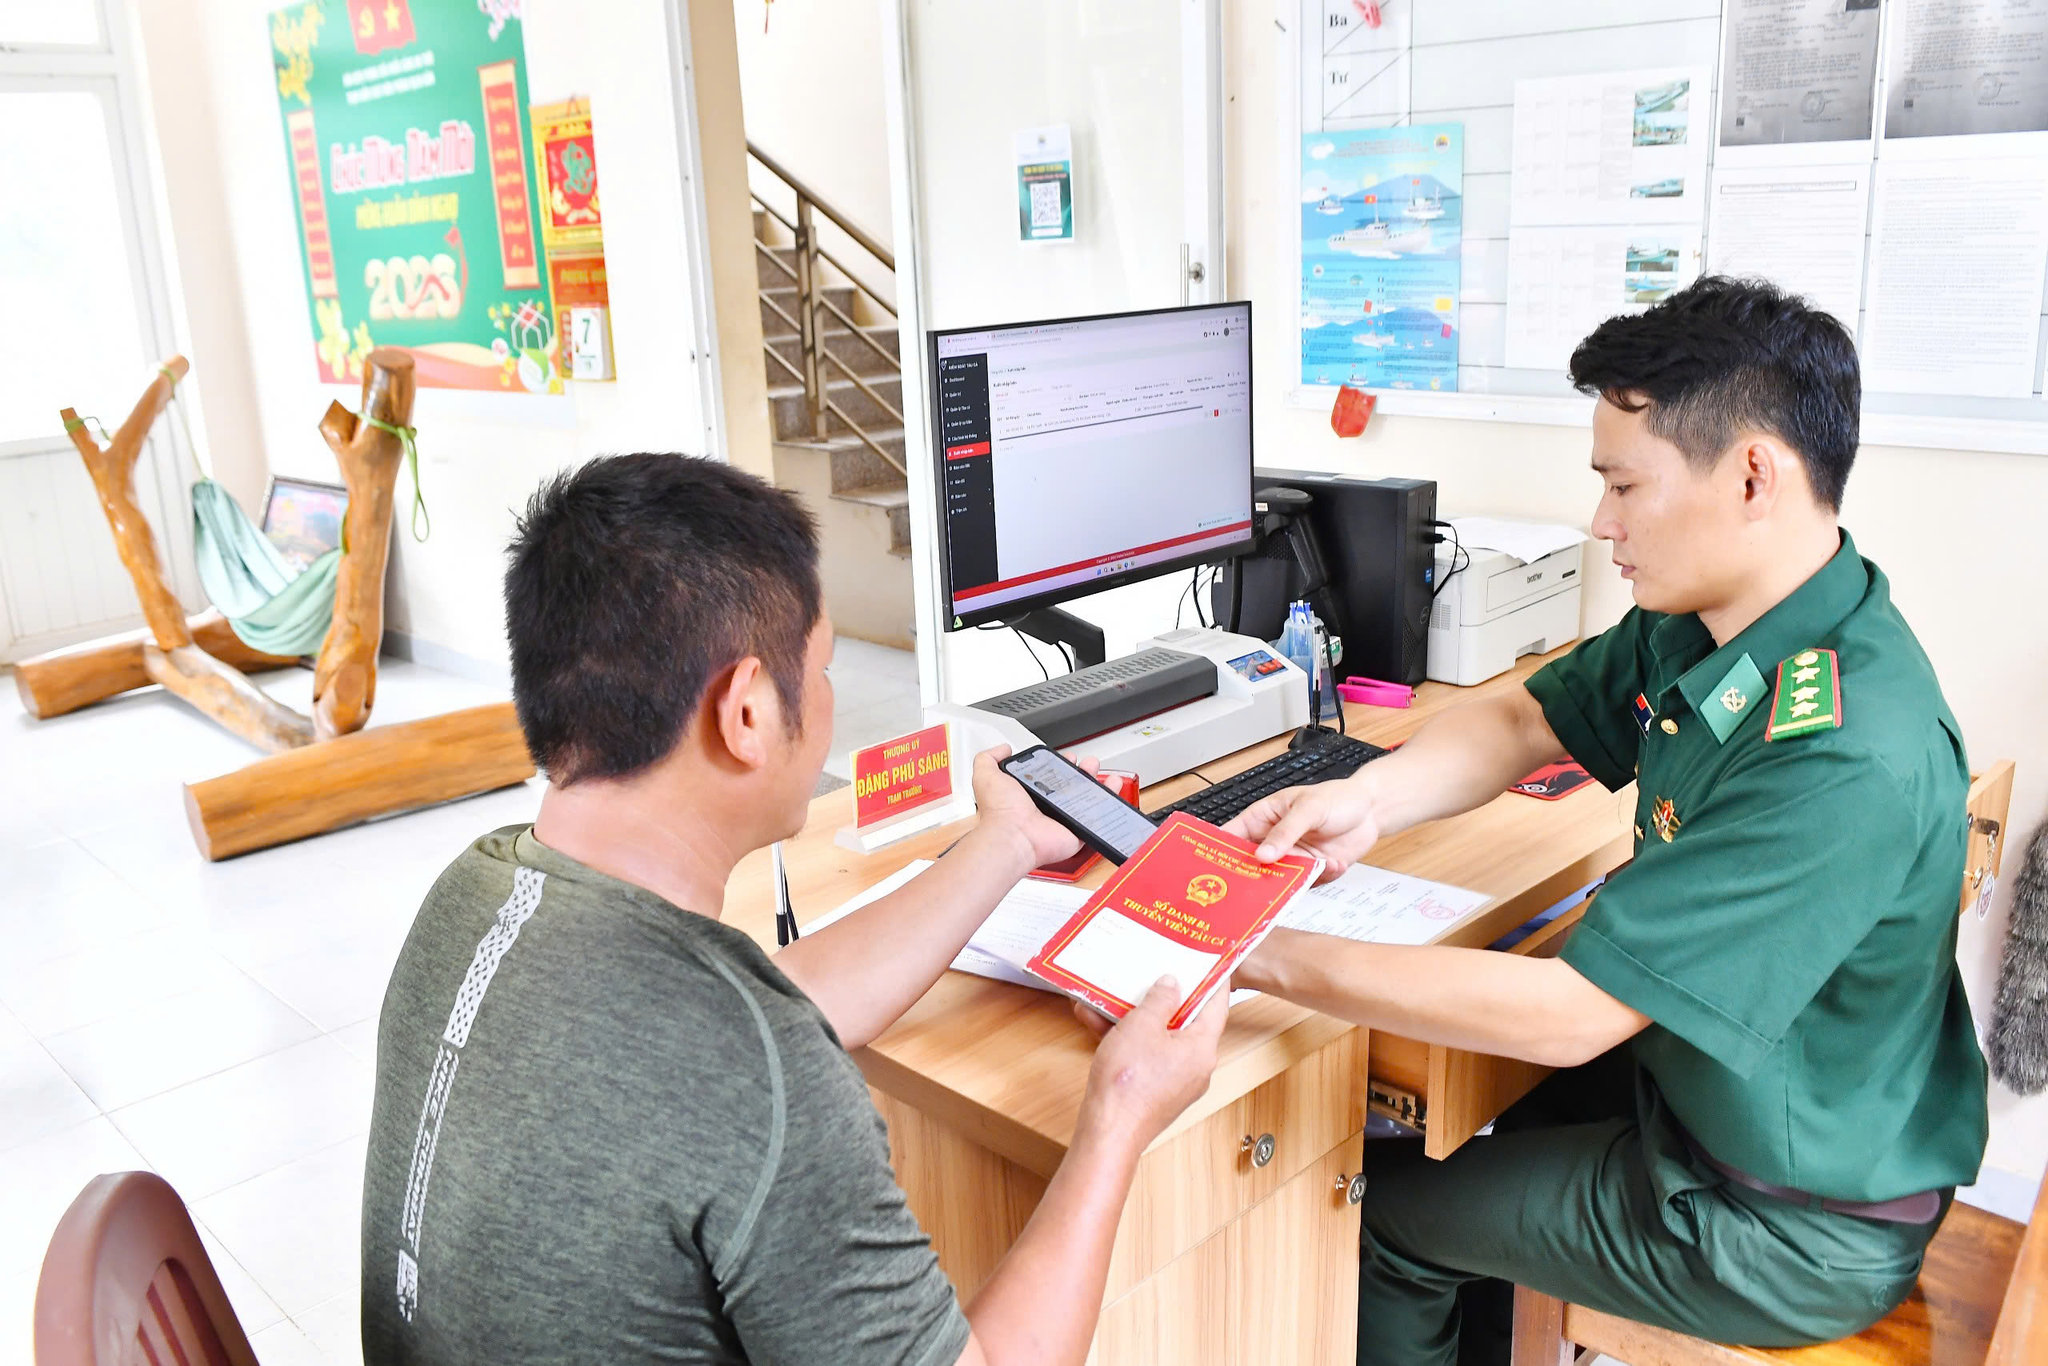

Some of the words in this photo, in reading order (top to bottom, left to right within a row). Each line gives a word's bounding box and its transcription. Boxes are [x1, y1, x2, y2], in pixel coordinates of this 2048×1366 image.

[1329, 14, 1348, 28] Ba
[581, 317, 591, 344] 7
[1526, 572, 1543, 584] brother
[883, 742, 910, 760] THƯỢNG
[857, 770, 889, 798] ĐẶNG
[892, 758, 916, 786] PHÚ
[918, 750, 948, 776] SÁNG
[1123, 897, 1166, 924] THUYỀN
[1165, 917, 1190, 935] VIÊN
[1190, 928, 1212, 942] TÀU
[1210, 937, 1227, 947] CÁ
[1152, 899, 1170, 912] SỔ
[1167, 905, 1199, 927] DANH
[1197, 918, 1212, 932] BẠ
[429, 1049, 453, 1117] NIKE
